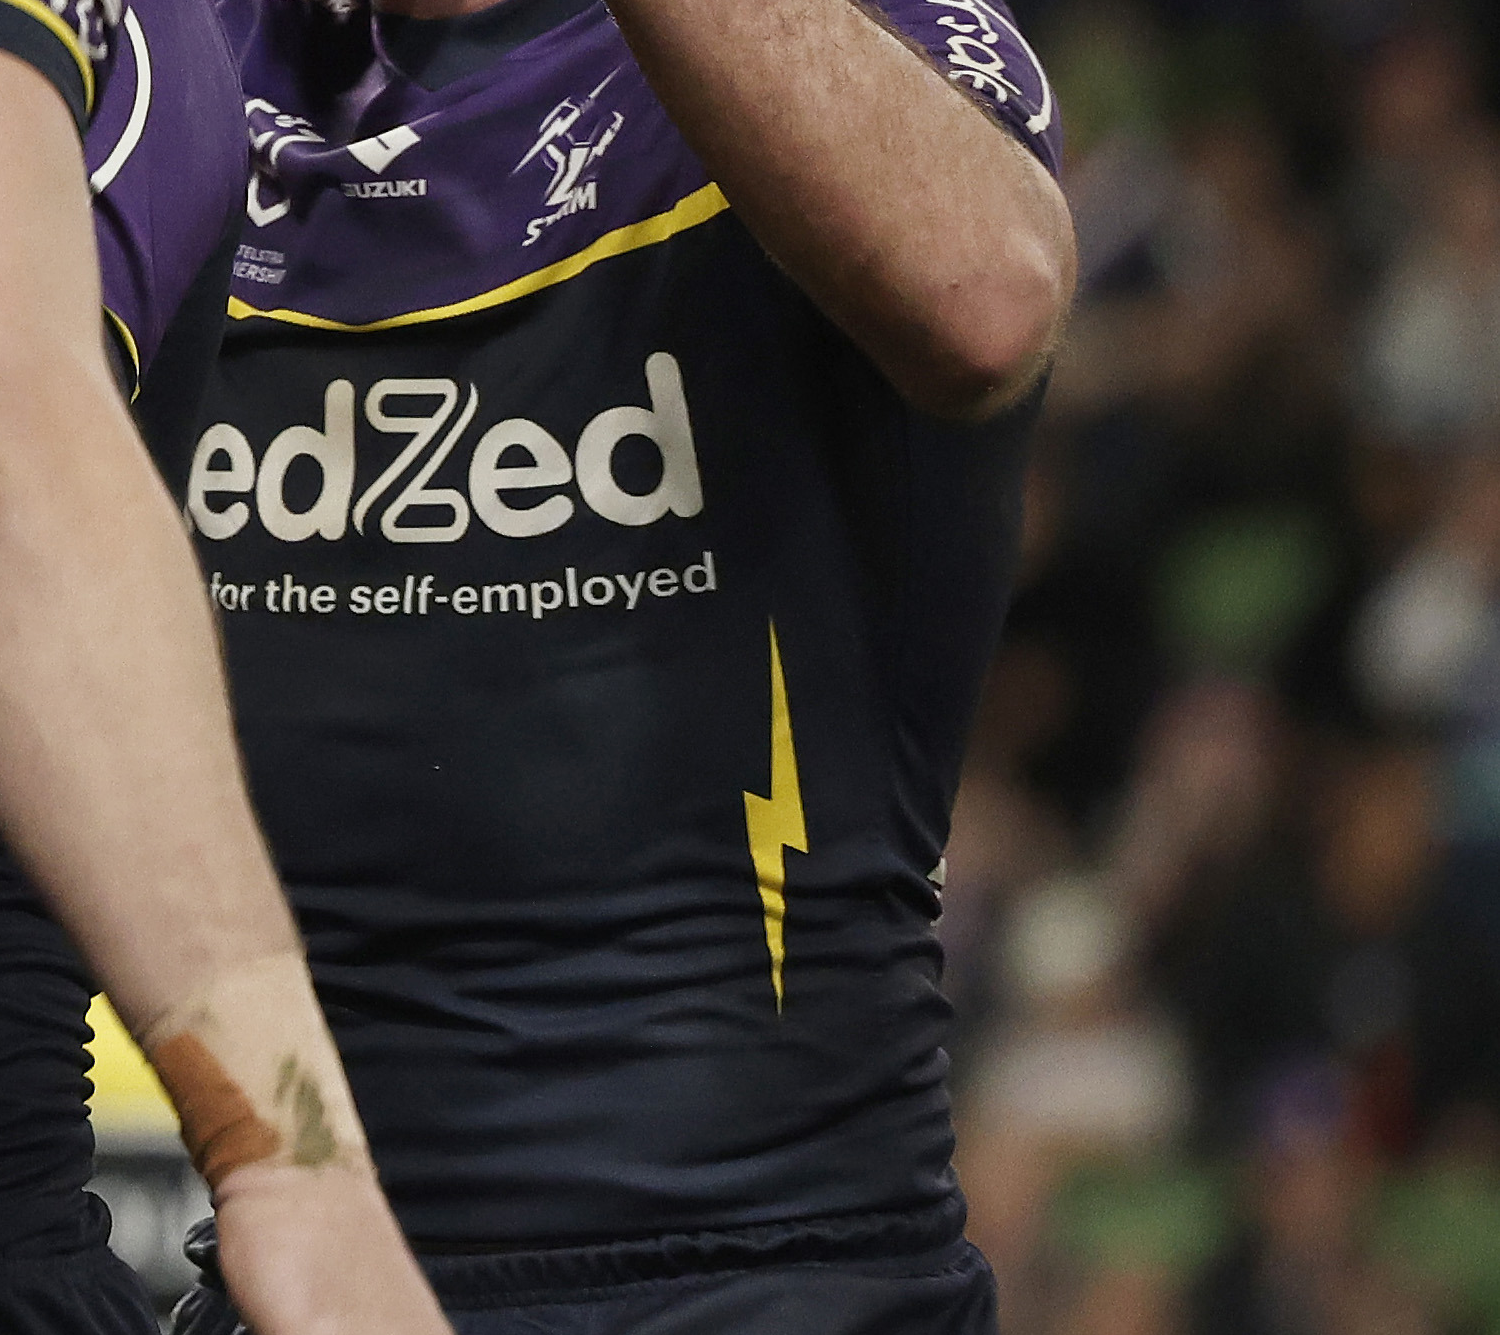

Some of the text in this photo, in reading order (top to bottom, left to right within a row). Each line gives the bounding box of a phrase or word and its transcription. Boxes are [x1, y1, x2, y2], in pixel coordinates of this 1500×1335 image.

[343, 177, 428, 199] SUZUKI
[265, 573, 336, 614] the
[349, 552, 717, 620] self-employed
